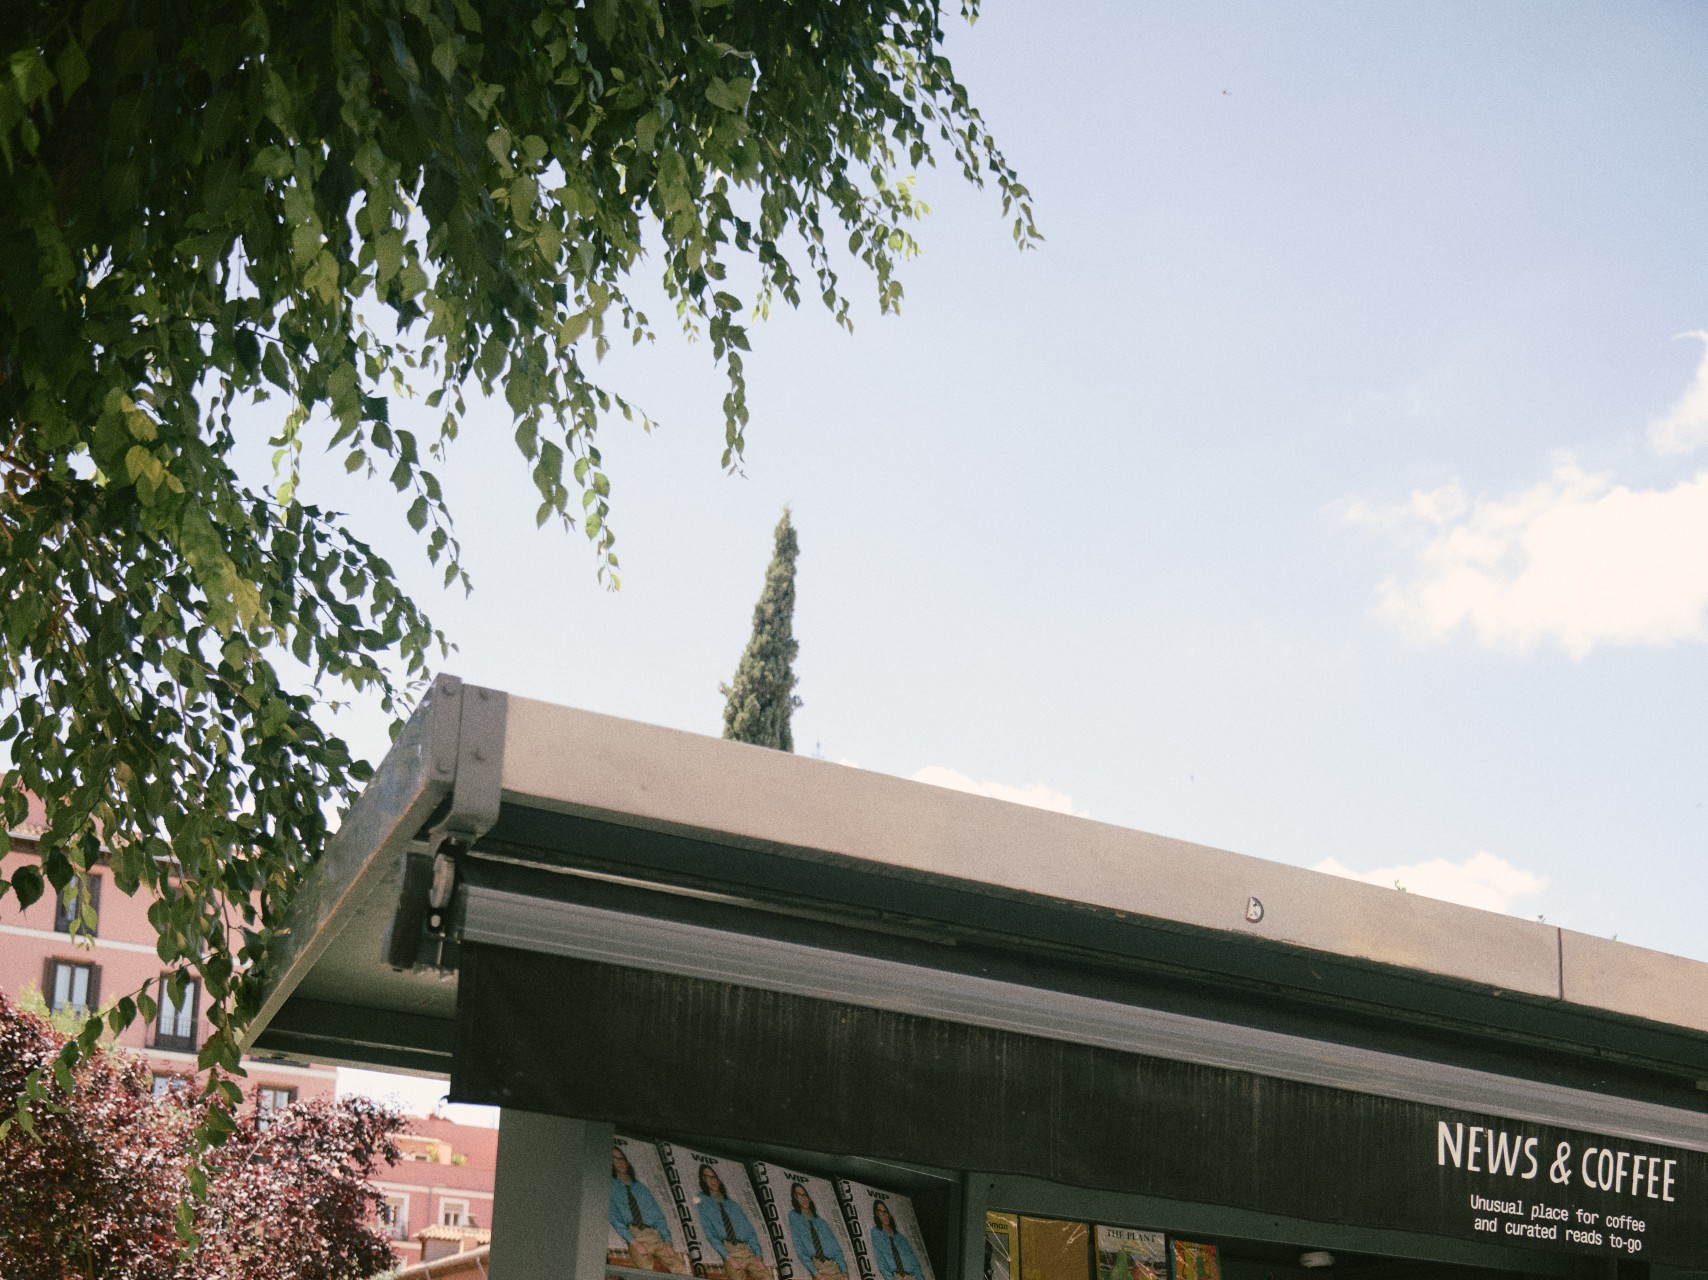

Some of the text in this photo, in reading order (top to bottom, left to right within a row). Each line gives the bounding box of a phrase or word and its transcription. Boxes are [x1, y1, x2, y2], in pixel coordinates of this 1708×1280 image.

[691, 1153, 719, 1166] WIP
[1438, 1121, 1677, 1202] NEWS & COFFEE
[784, 1171, 810, 1184] WIP
[866, 1188, 890, 1201] WIP
[1470, 1194, 1646, 1233] Unusual place for coffee
[1106, 1229, 1158, 1243] THE PLANT
[1474, 1217, 1642, 1254] and curated reads to-go
